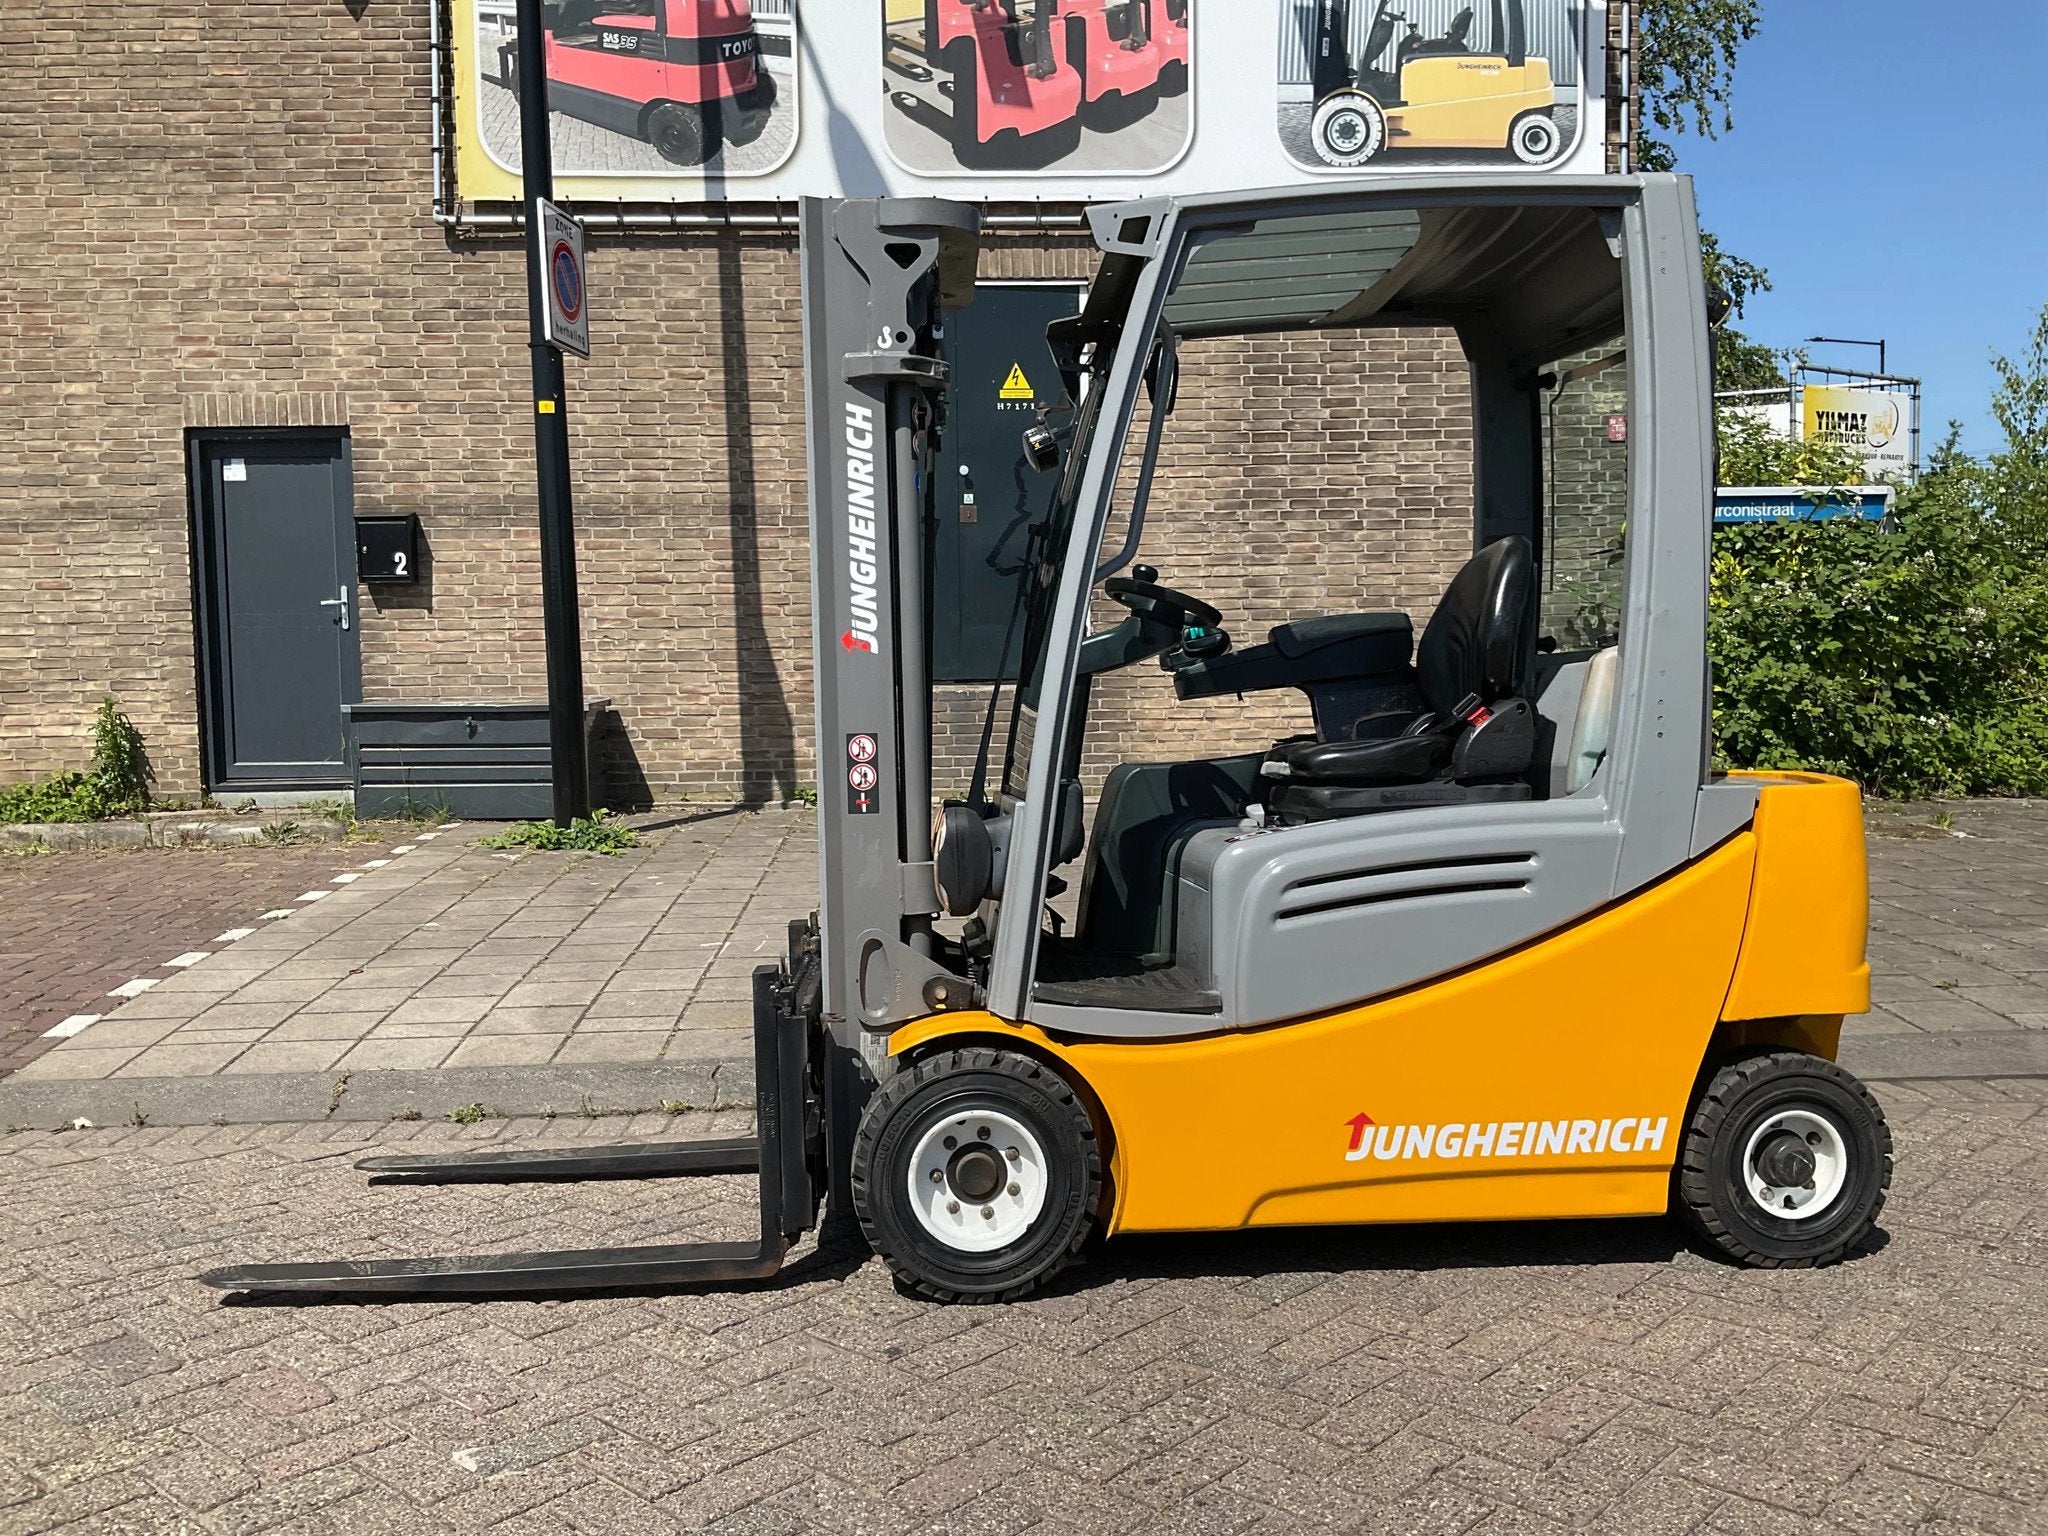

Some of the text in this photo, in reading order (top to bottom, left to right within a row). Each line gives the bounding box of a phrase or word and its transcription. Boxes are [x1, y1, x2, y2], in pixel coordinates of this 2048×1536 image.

[602, 32, 619, 43] SAS
[618, 35, 638, 50] 35
[554, 217, 574, 240] ZONE
[555, 320, 585, 349] herhaling
[1816, 410, 1867, 432] YILMAZ
[844, 402, 878, 655] JUNGHEINRICH
[394, 552, 408, 576] 2
[1344, 1115, 1668, 1162] JUNGHEINRICH
